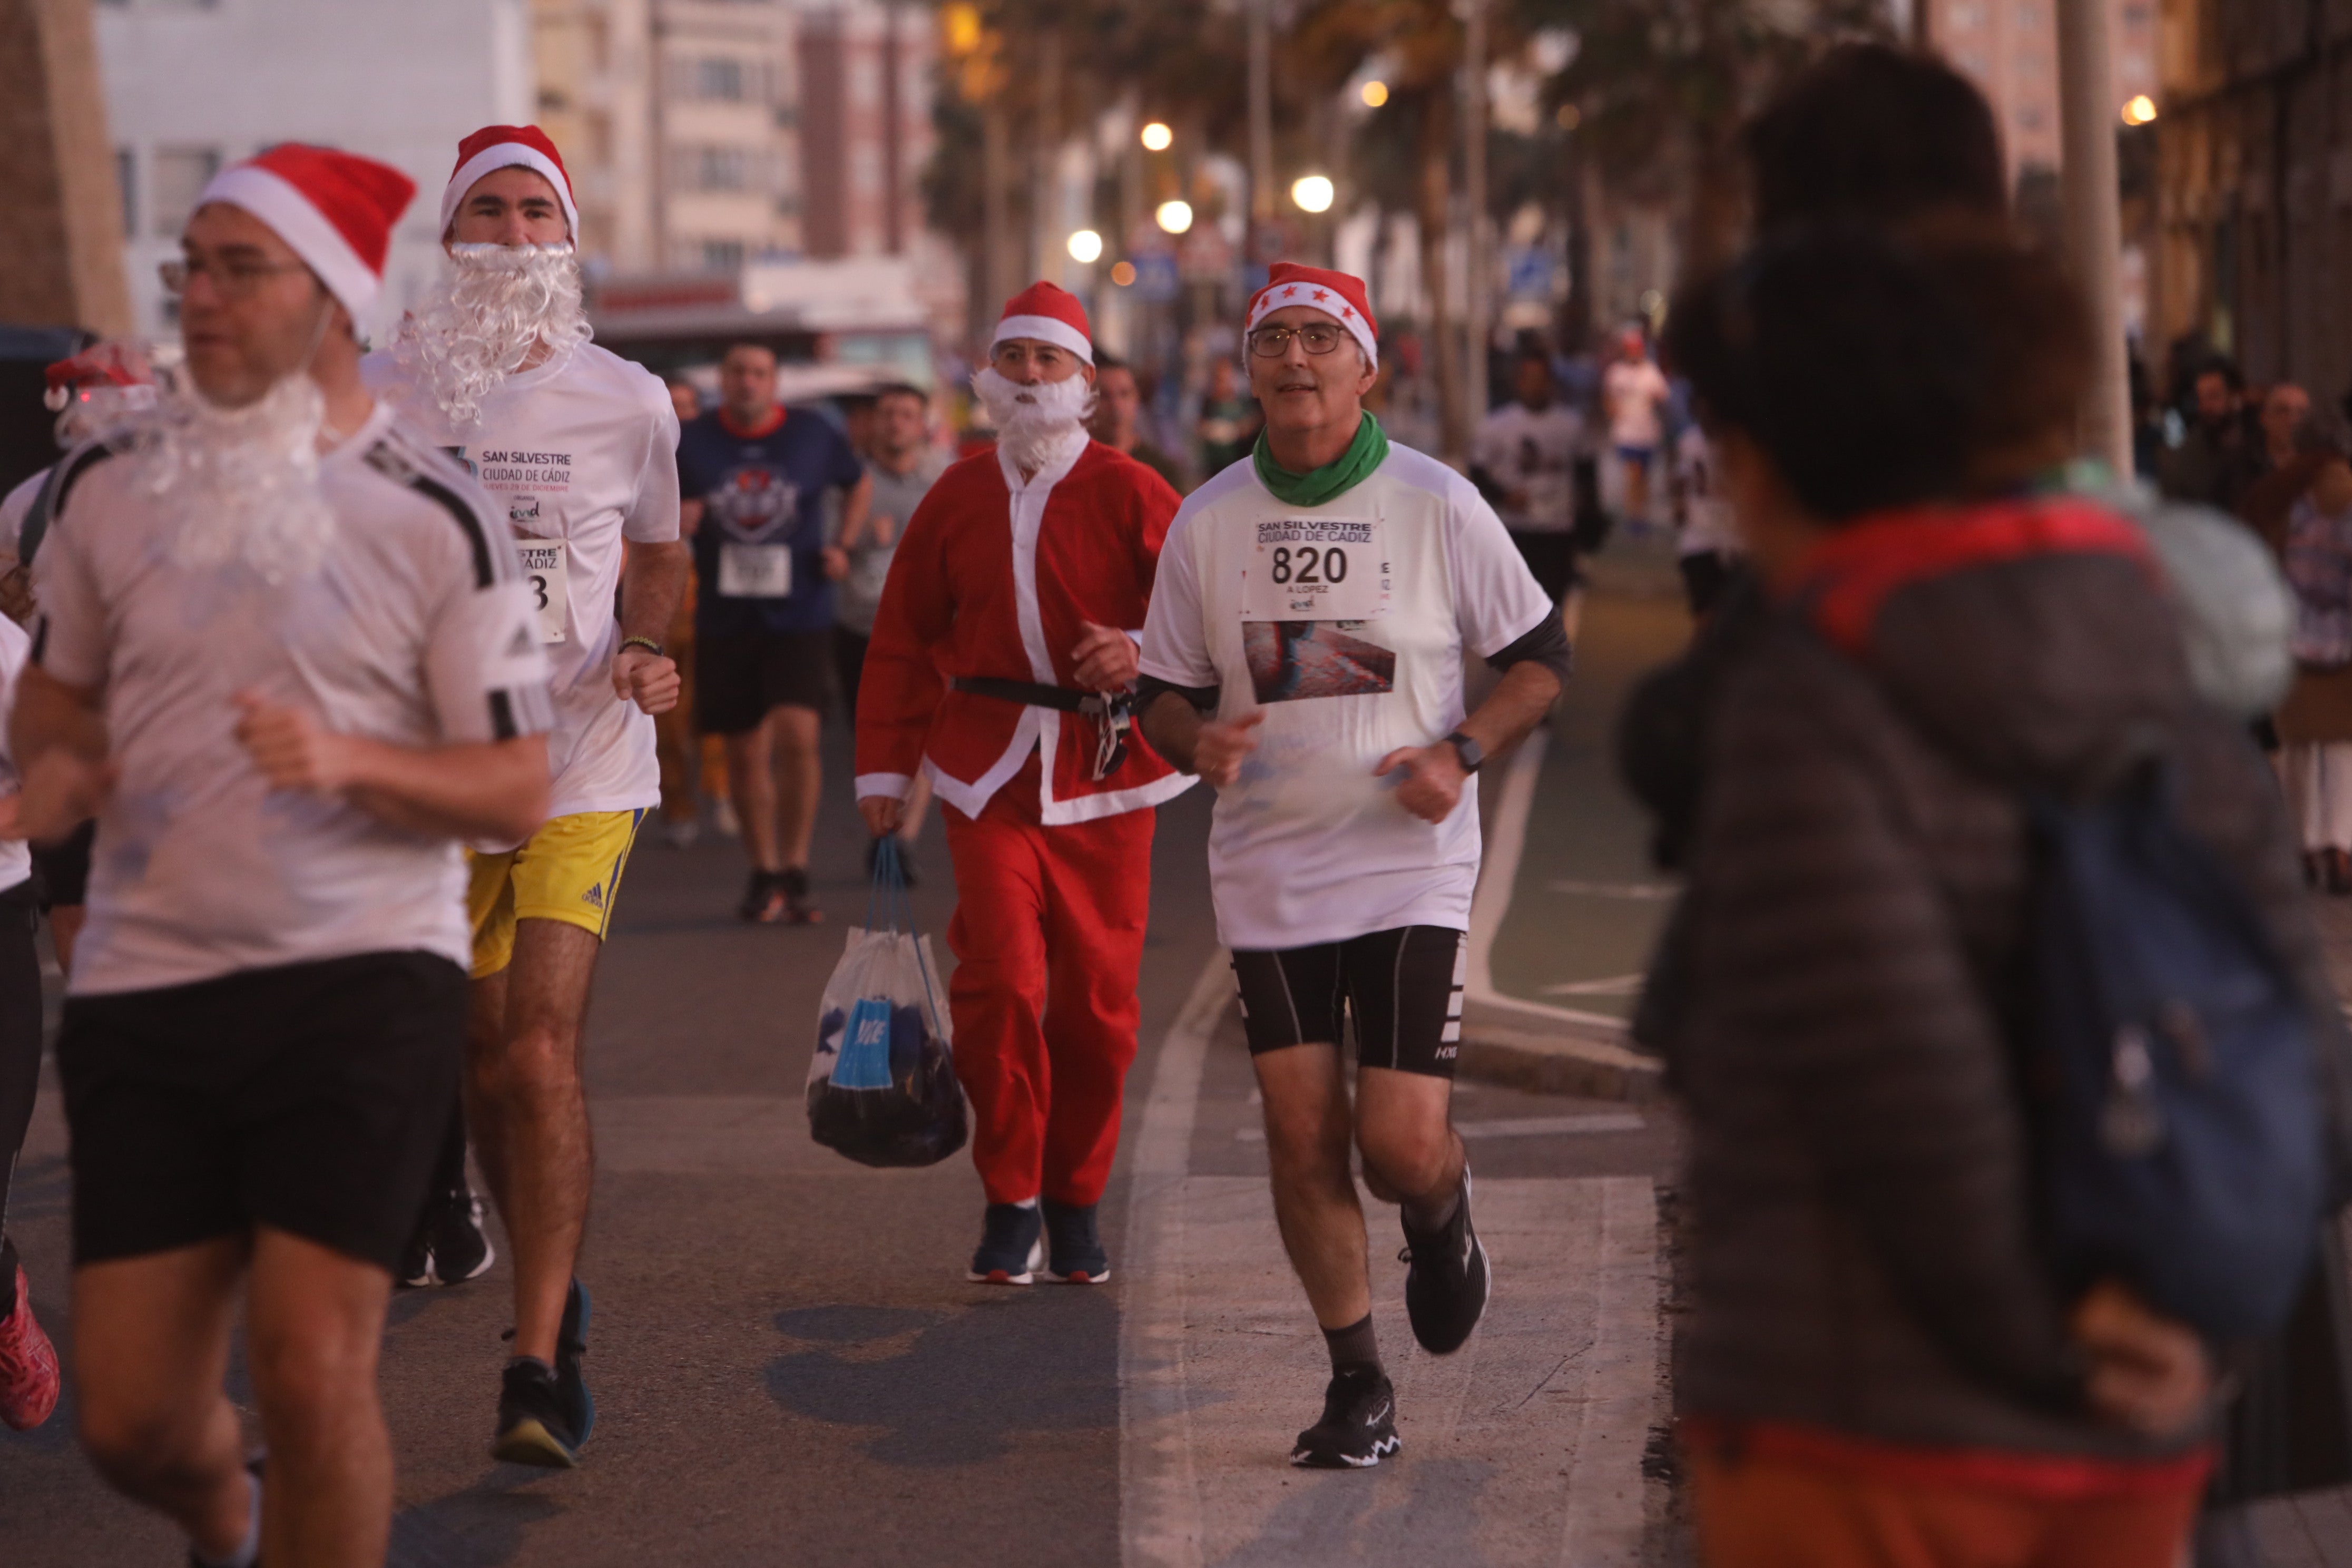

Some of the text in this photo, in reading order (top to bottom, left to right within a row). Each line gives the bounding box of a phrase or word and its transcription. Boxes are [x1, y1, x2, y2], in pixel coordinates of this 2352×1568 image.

[483, 451, 571, 465] SAN SILVESTRE
[483, 468, 570, 483] CIUDAD DE CÁDIZ
[1258, 522, 1371, 532] SAN SILVESTRE
[1258, 530, 1301, 543] CIUDAD
[1305, 531, 1324, 542] DE
[517, 548, 556, 557] STRE
[522, 558, 556, 569] ADIZ
[1272, 546, 1347, 584] 820
